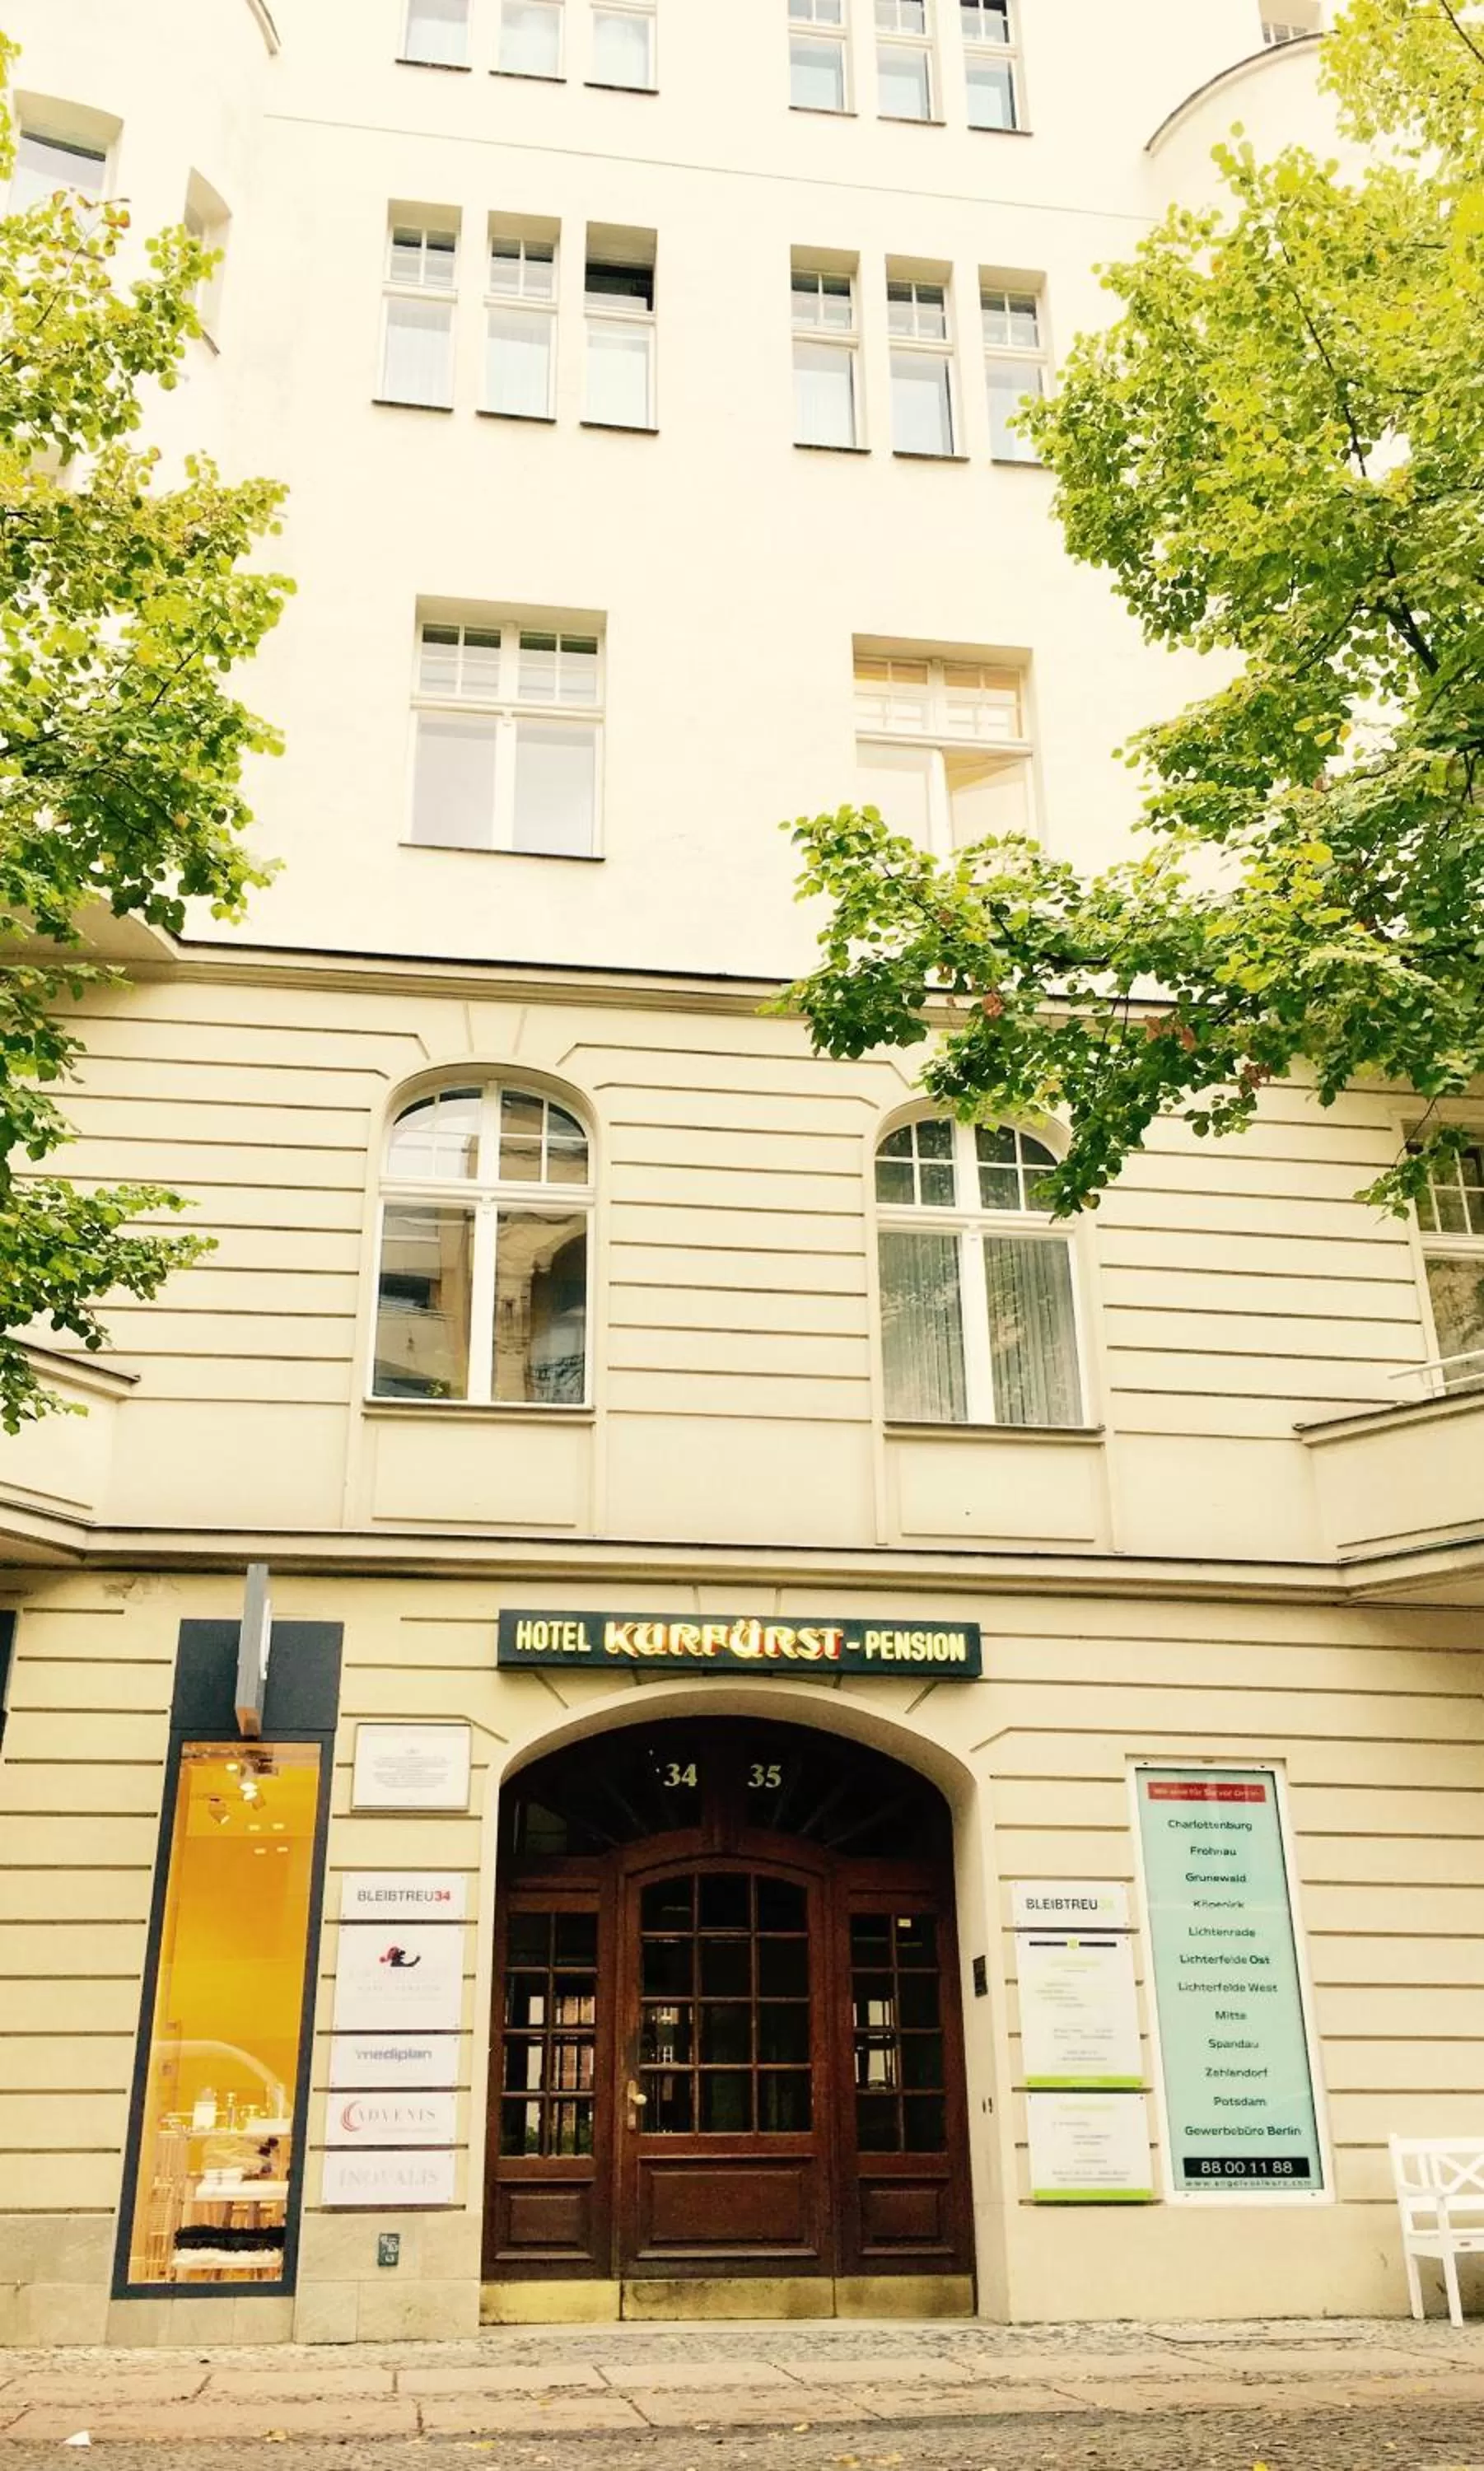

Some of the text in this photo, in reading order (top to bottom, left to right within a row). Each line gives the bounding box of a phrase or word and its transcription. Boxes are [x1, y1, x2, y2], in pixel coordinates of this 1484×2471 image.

[516, 1621, 591, 1651] HOTEL
[664, 1763, 698, 1787] 34
[748, 1763, 782, 1788] 35
[1168, 1819, 1253, 1831] Charlottenburg
[1190, 1846, 1237, 1856] Frohnau
[1186, 1873, 1247, 1883] Grunewald
[357, 1890, 451, 1902] BLEIBTREU34
[1025, 1899, 1115, 1910] BLEIBTREU
[1188, 1927, 1256, 1936] Lichtenrade
[1179, 1955, 1270, 1965] Lichterfelde Ost
[1178, 1983, 1277, 1992] Lichterfelde West
[1215, 2011, 1247, 2020] Mitte
[1208, 2039, 1259, 2049] Spandau
[1206, 2067, 1267, 2077] Zehlendorf
[1213, 2097, 1267, 2107] Potsdam
[1185, 2127, 1301, 2137] Gewerbebüro Berlin
[1201, 2161, 1293, 2174] 88 00 11 88
